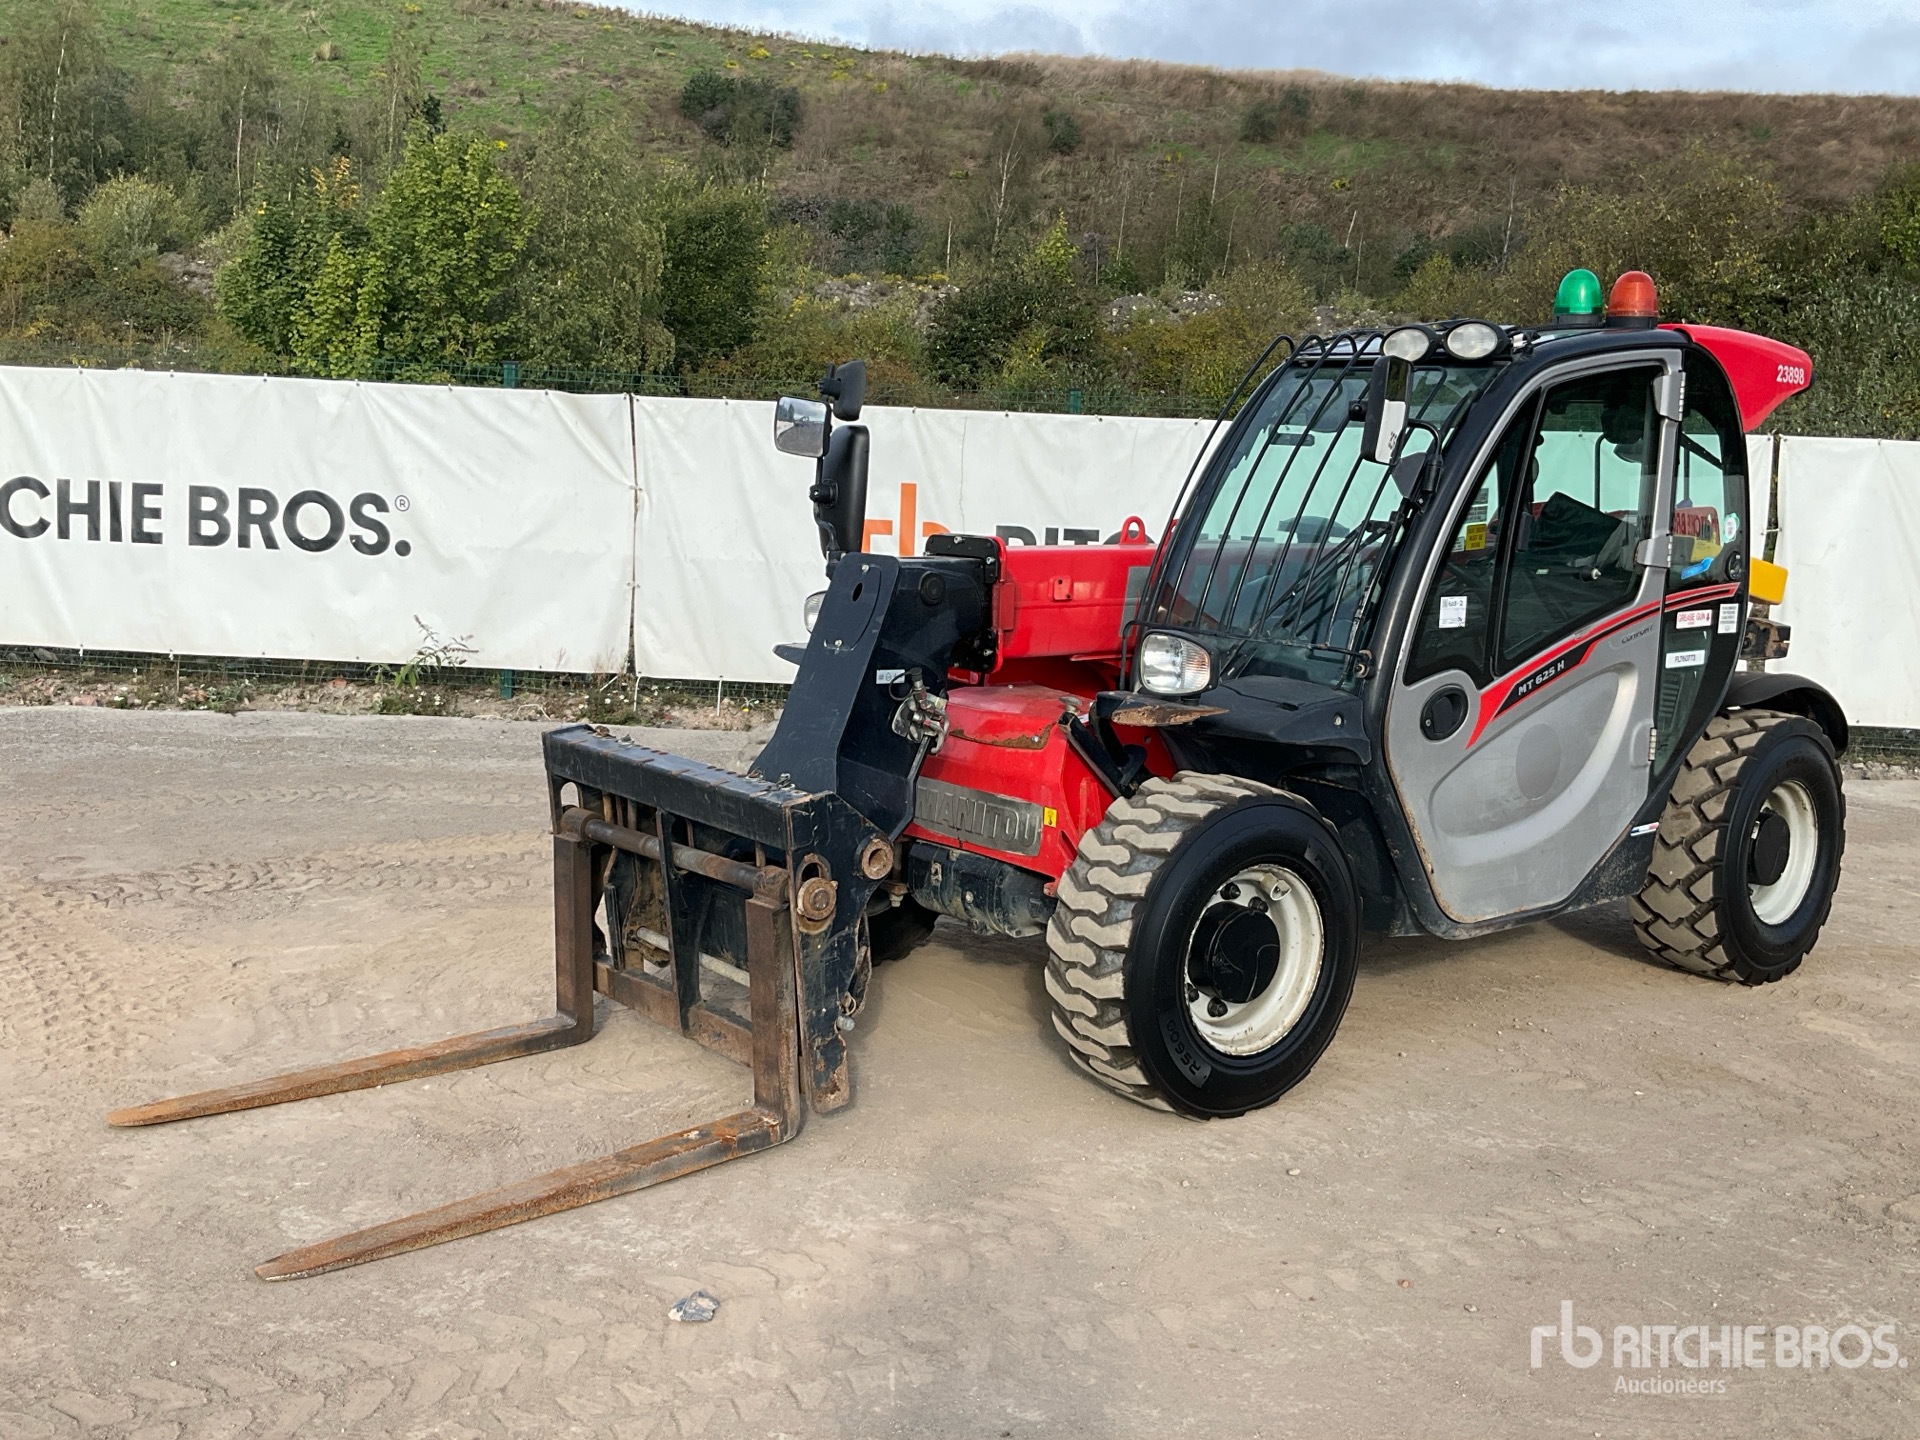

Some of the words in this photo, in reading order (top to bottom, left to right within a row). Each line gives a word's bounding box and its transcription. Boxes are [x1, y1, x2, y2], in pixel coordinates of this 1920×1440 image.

[1776, 364, 1805, 385] 23898
[1518, 679, 1535, 696] MT
[1535, 666, 1556, 685] 625
[1557, 659, 1565, 672] H
[914, 785, 1039, 848] MANITOU
